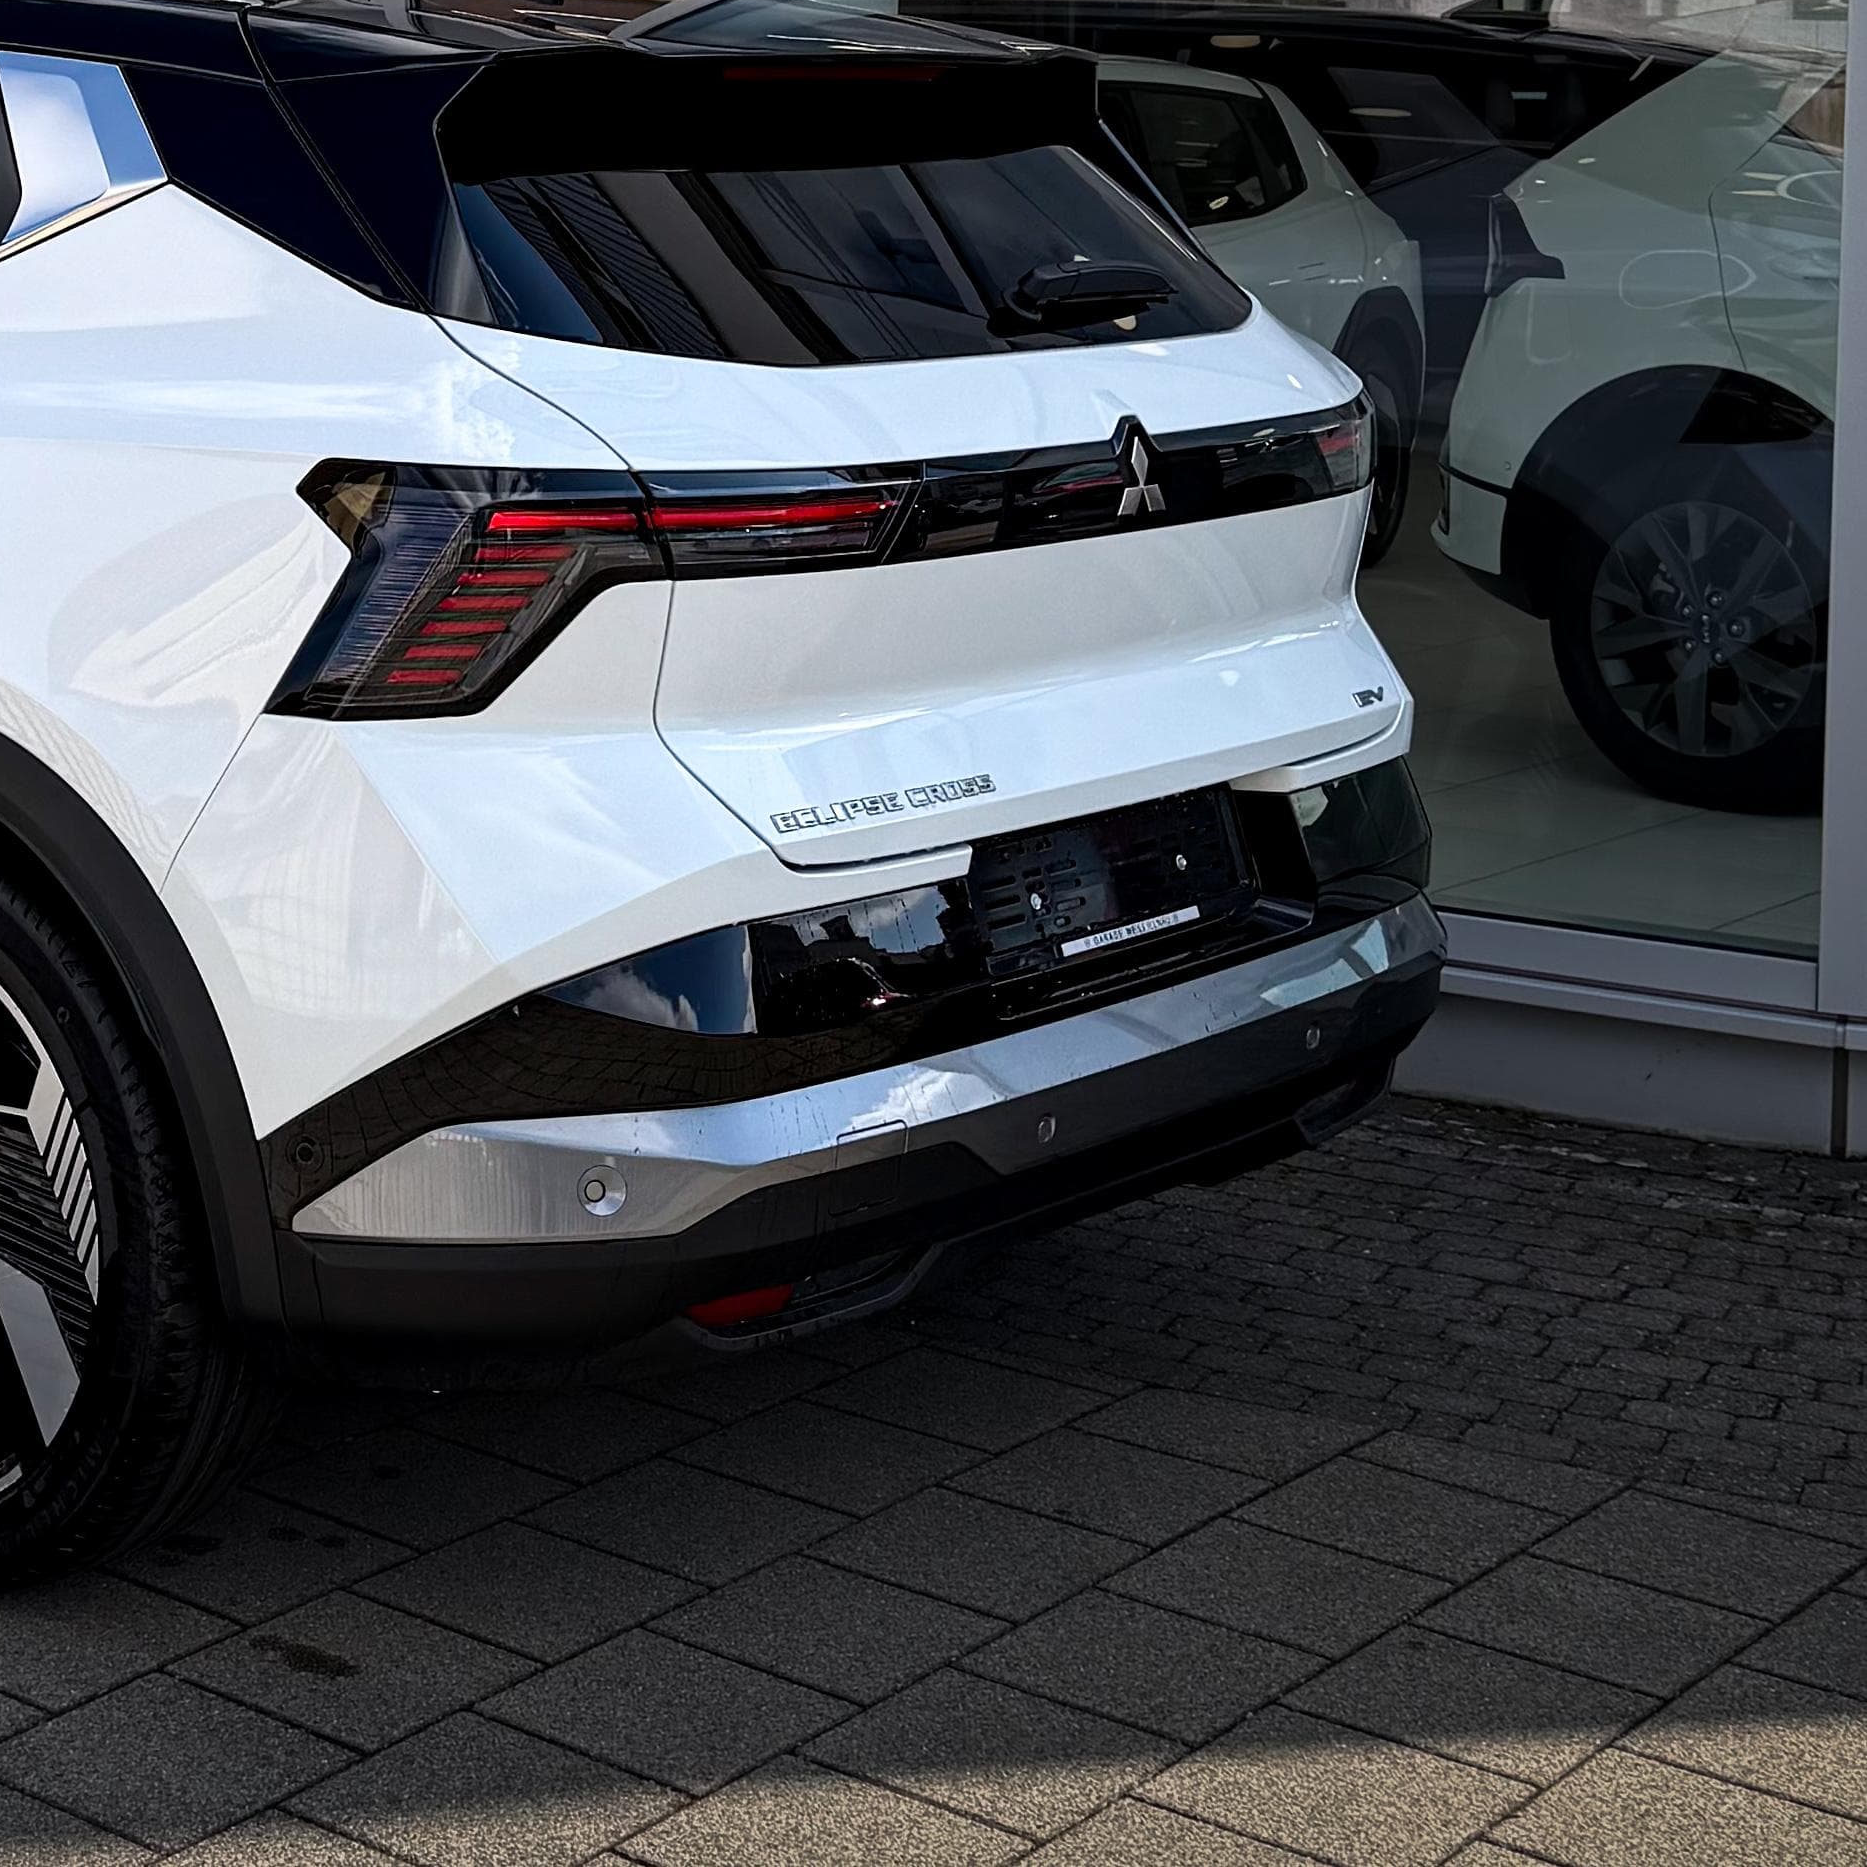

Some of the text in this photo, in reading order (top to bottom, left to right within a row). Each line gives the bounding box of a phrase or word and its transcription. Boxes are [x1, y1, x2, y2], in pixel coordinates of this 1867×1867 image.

[1352, 686, 1383, 708] EV
[770, 774, 997, 834] ECLIPSE CROSS
